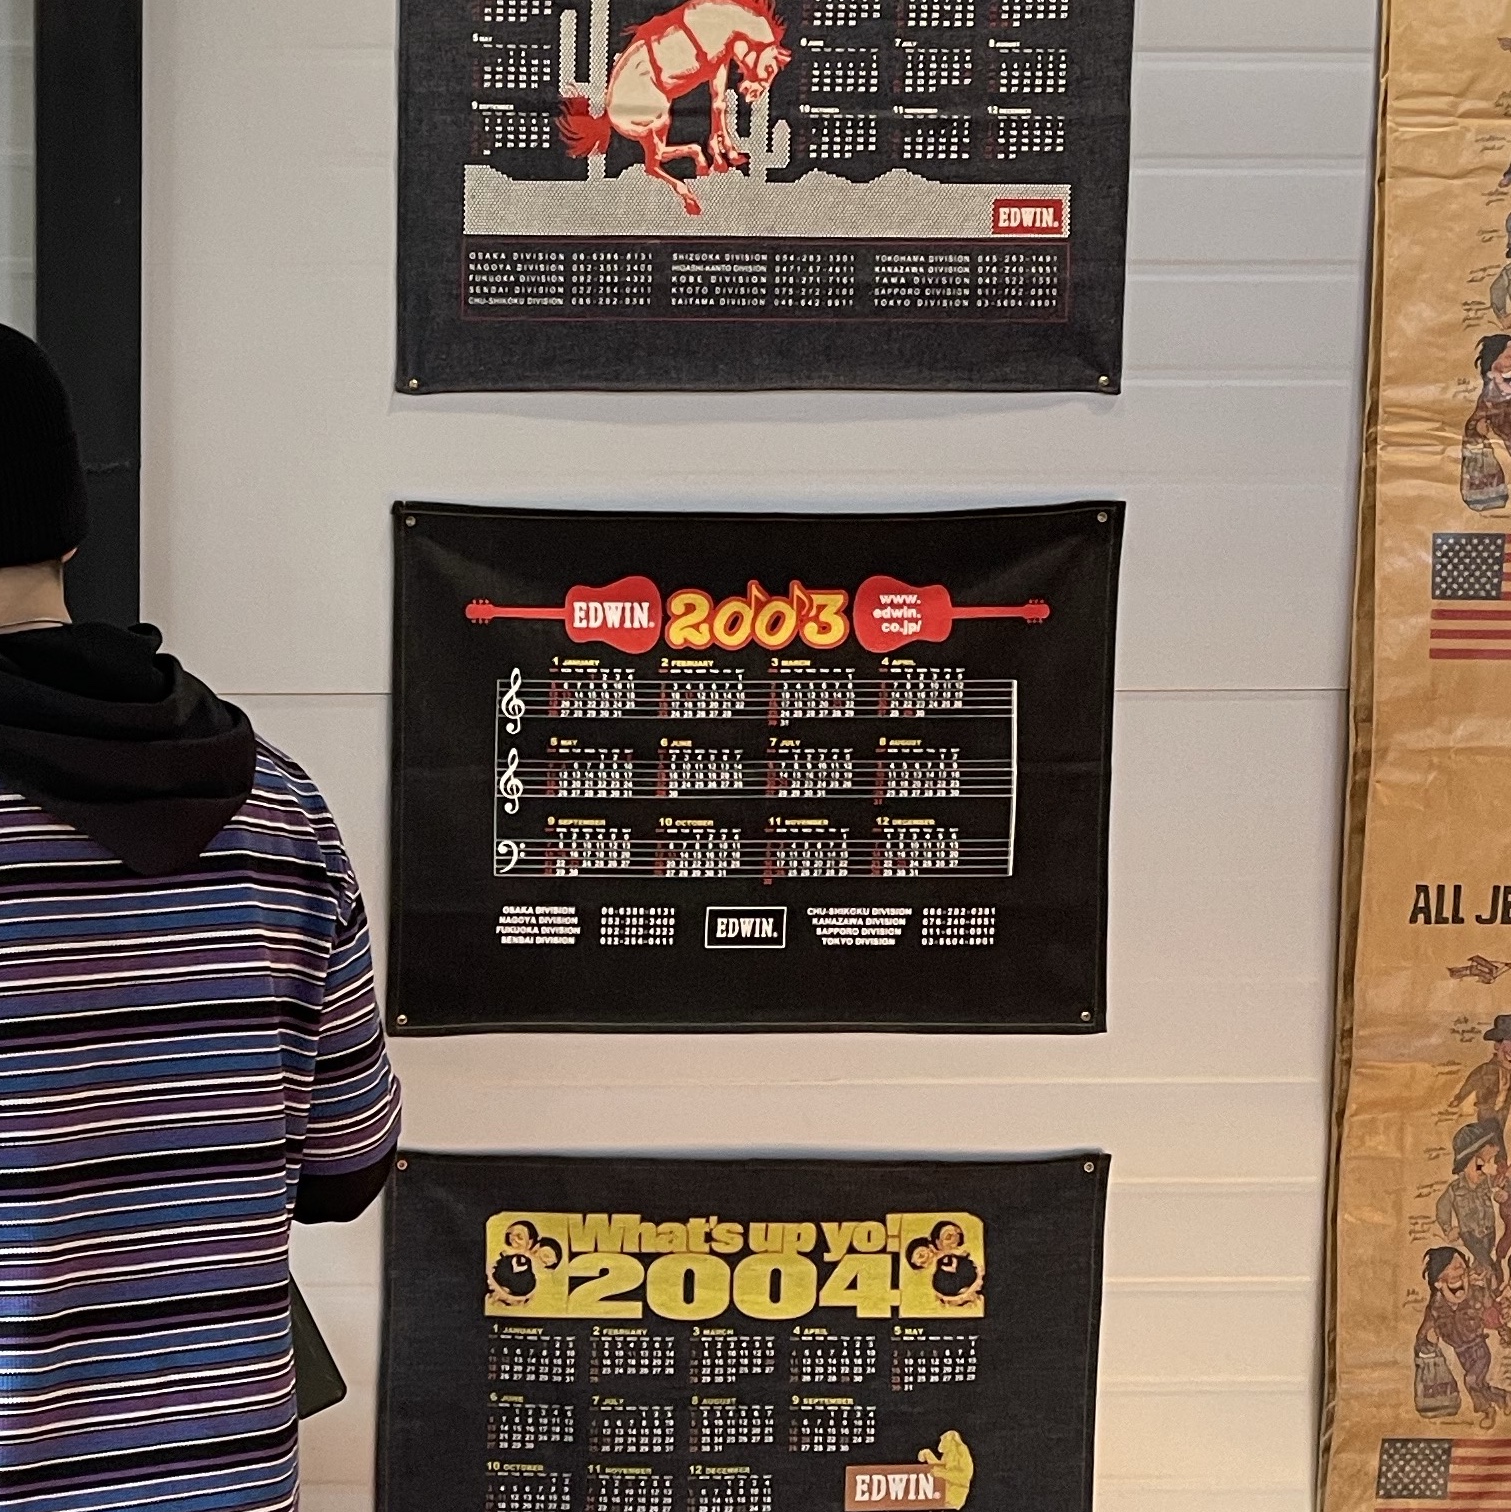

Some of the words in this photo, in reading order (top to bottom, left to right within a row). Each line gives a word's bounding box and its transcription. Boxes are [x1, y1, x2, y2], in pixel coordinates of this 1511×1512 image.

[879, 594, 922, 605] www.
[872, 606, 922, 620] edwin.
[667, 590, 848, 649] 2003
[881, 620, 922, 636] co.jp/
[553, 657, 558, 665] 1
[661, 658, 668, 667] 2
[772, 658, 778, 666] 3
[882, 657, 889, 665] 4
[770, 738, 776, 746] 7
[659, 818, 672, 826] 10
[770, 817, 780, 825] 11
[876, 817, 889, 825] 12
[1410, 884, 1464, 925] ALL
[499, 916, 536, 927] NAGOYA
[569, 1213, 745, 1255] What's
[747, 1221, 818, 1257] up
[818, 1212, 902, 1262] yo!
[568, 1253, 903, 1320] 2004
[493, 1324, 498, 1332] 1
[593, 1326, 600, 1335] 2
[693, 1327, 700, 1336] 3
[793, 1326, 800, 1334] 4
[905, 1329, 923, 1337] MAY
[490, 1393, 497, 1401] 6
[592, 1396, 599, 1404] 7
[792, 1395, 799, 1404] 9
[488, 1462, 500, 1470] 10
[589, 1465, 600, 1473] 11
[690, 1465, 702, 1474] 12
